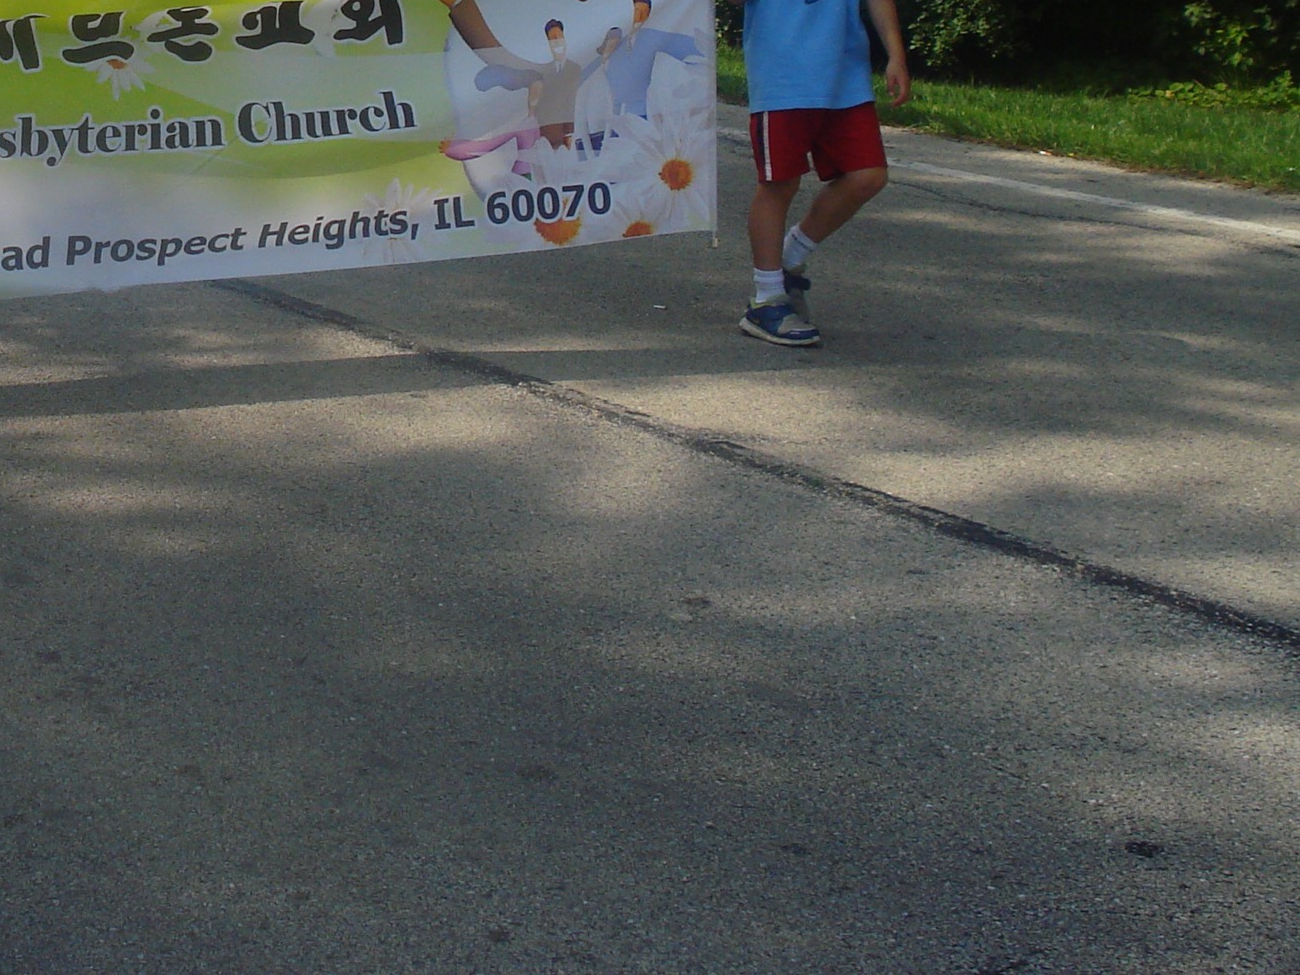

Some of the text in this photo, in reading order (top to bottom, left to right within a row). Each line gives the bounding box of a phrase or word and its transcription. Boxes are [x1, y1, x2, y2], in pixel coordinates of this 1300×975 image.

[237, 91, 418, 145] Church
[66, 228, 246, 266] Prospect
[258, 208, 419, 249] Heights,
[433, 196, 476, 231] IL
[486, 181, 612, 224] 60070
